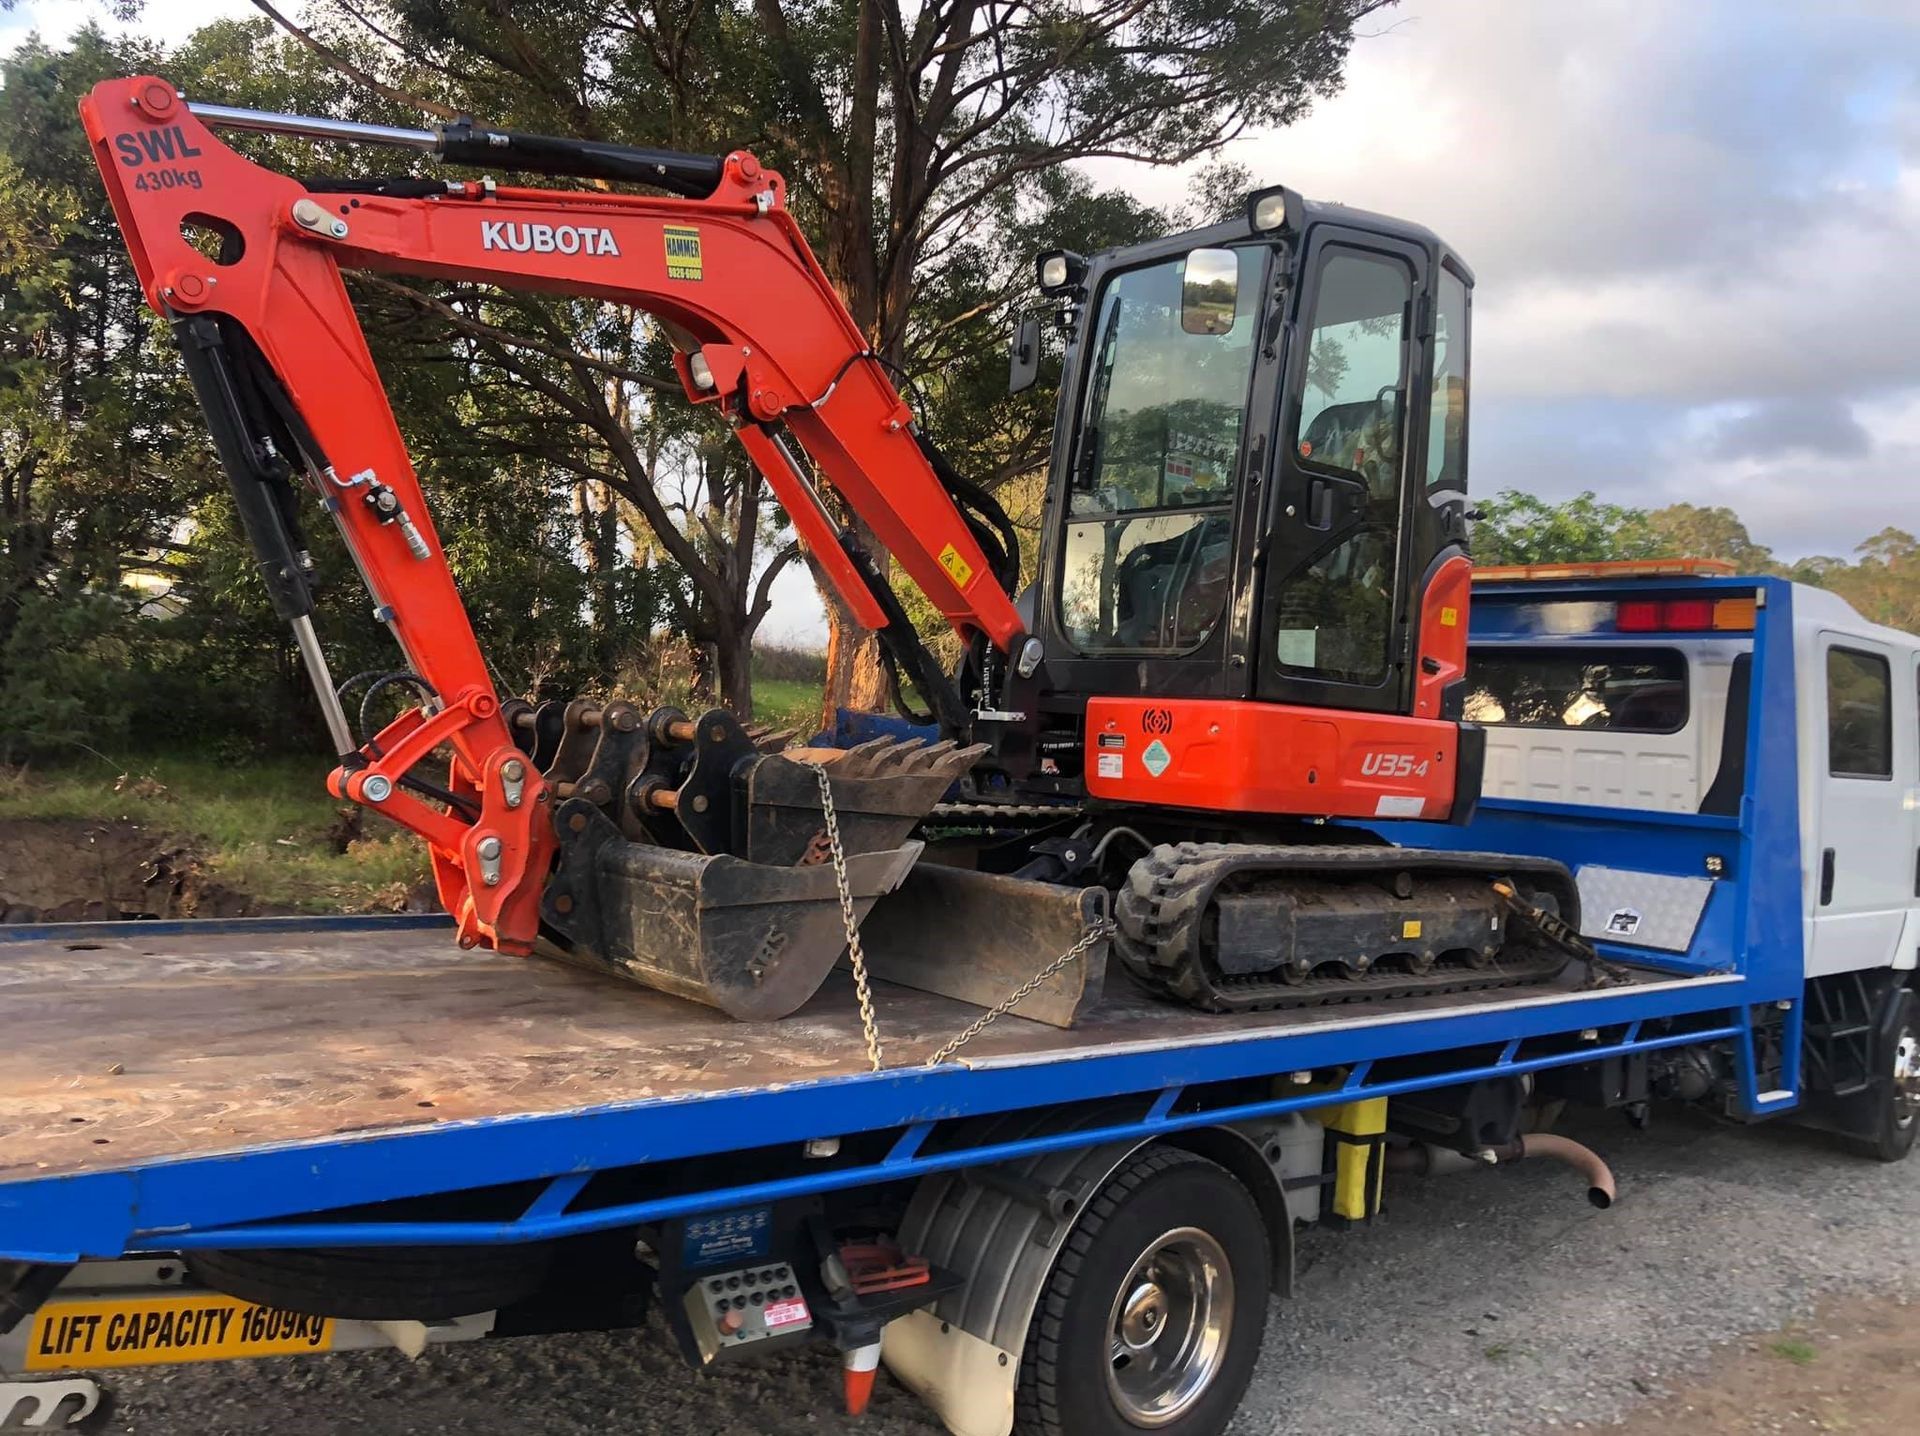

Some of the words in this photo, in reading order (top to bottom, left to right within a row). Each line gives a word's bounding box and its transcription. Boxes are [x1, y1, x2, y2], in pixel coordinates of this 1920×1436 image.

[115, 126, 202, 168] SWL
[135, 168, 203, 192] 430kg
[480, 220, 621, 257] KUBOTA
[666, 237, 700, 258] HAMMER
[1361, 752, 1429, 777] U35-4
[39, 1315, 102, 1355] LIFT
[105, 1306, 235, 1351] CAPACITY
[240, 1305, 324, 1346] 1609kg
